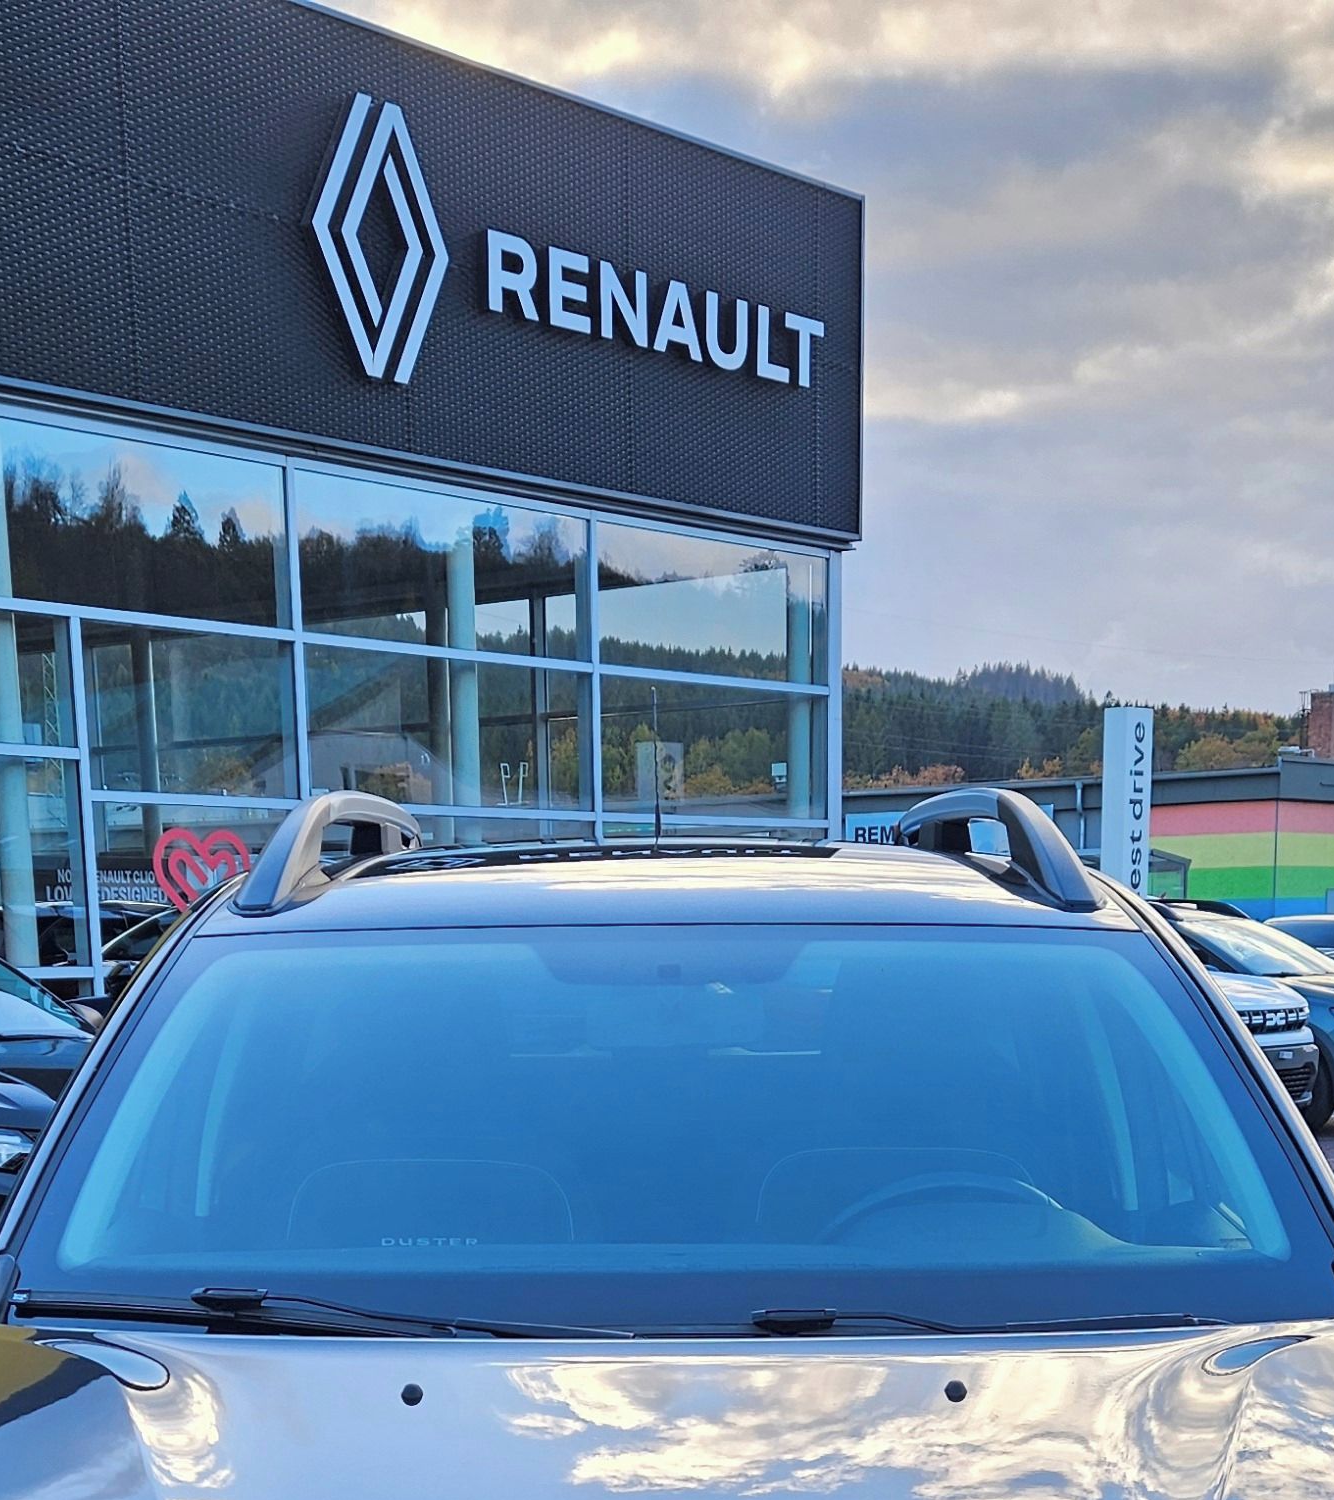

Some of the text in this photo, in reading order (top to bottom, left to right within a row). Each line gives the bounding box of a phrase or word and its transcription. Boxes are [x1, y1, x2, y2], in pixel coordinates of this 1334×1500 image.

[487, 228, 824, 388] RENAULT
[1129, 721, 1146, 896] est drive
[132, 870, 155, 884] CLIO
[381, 1237, 478, 1246] DUSTER
